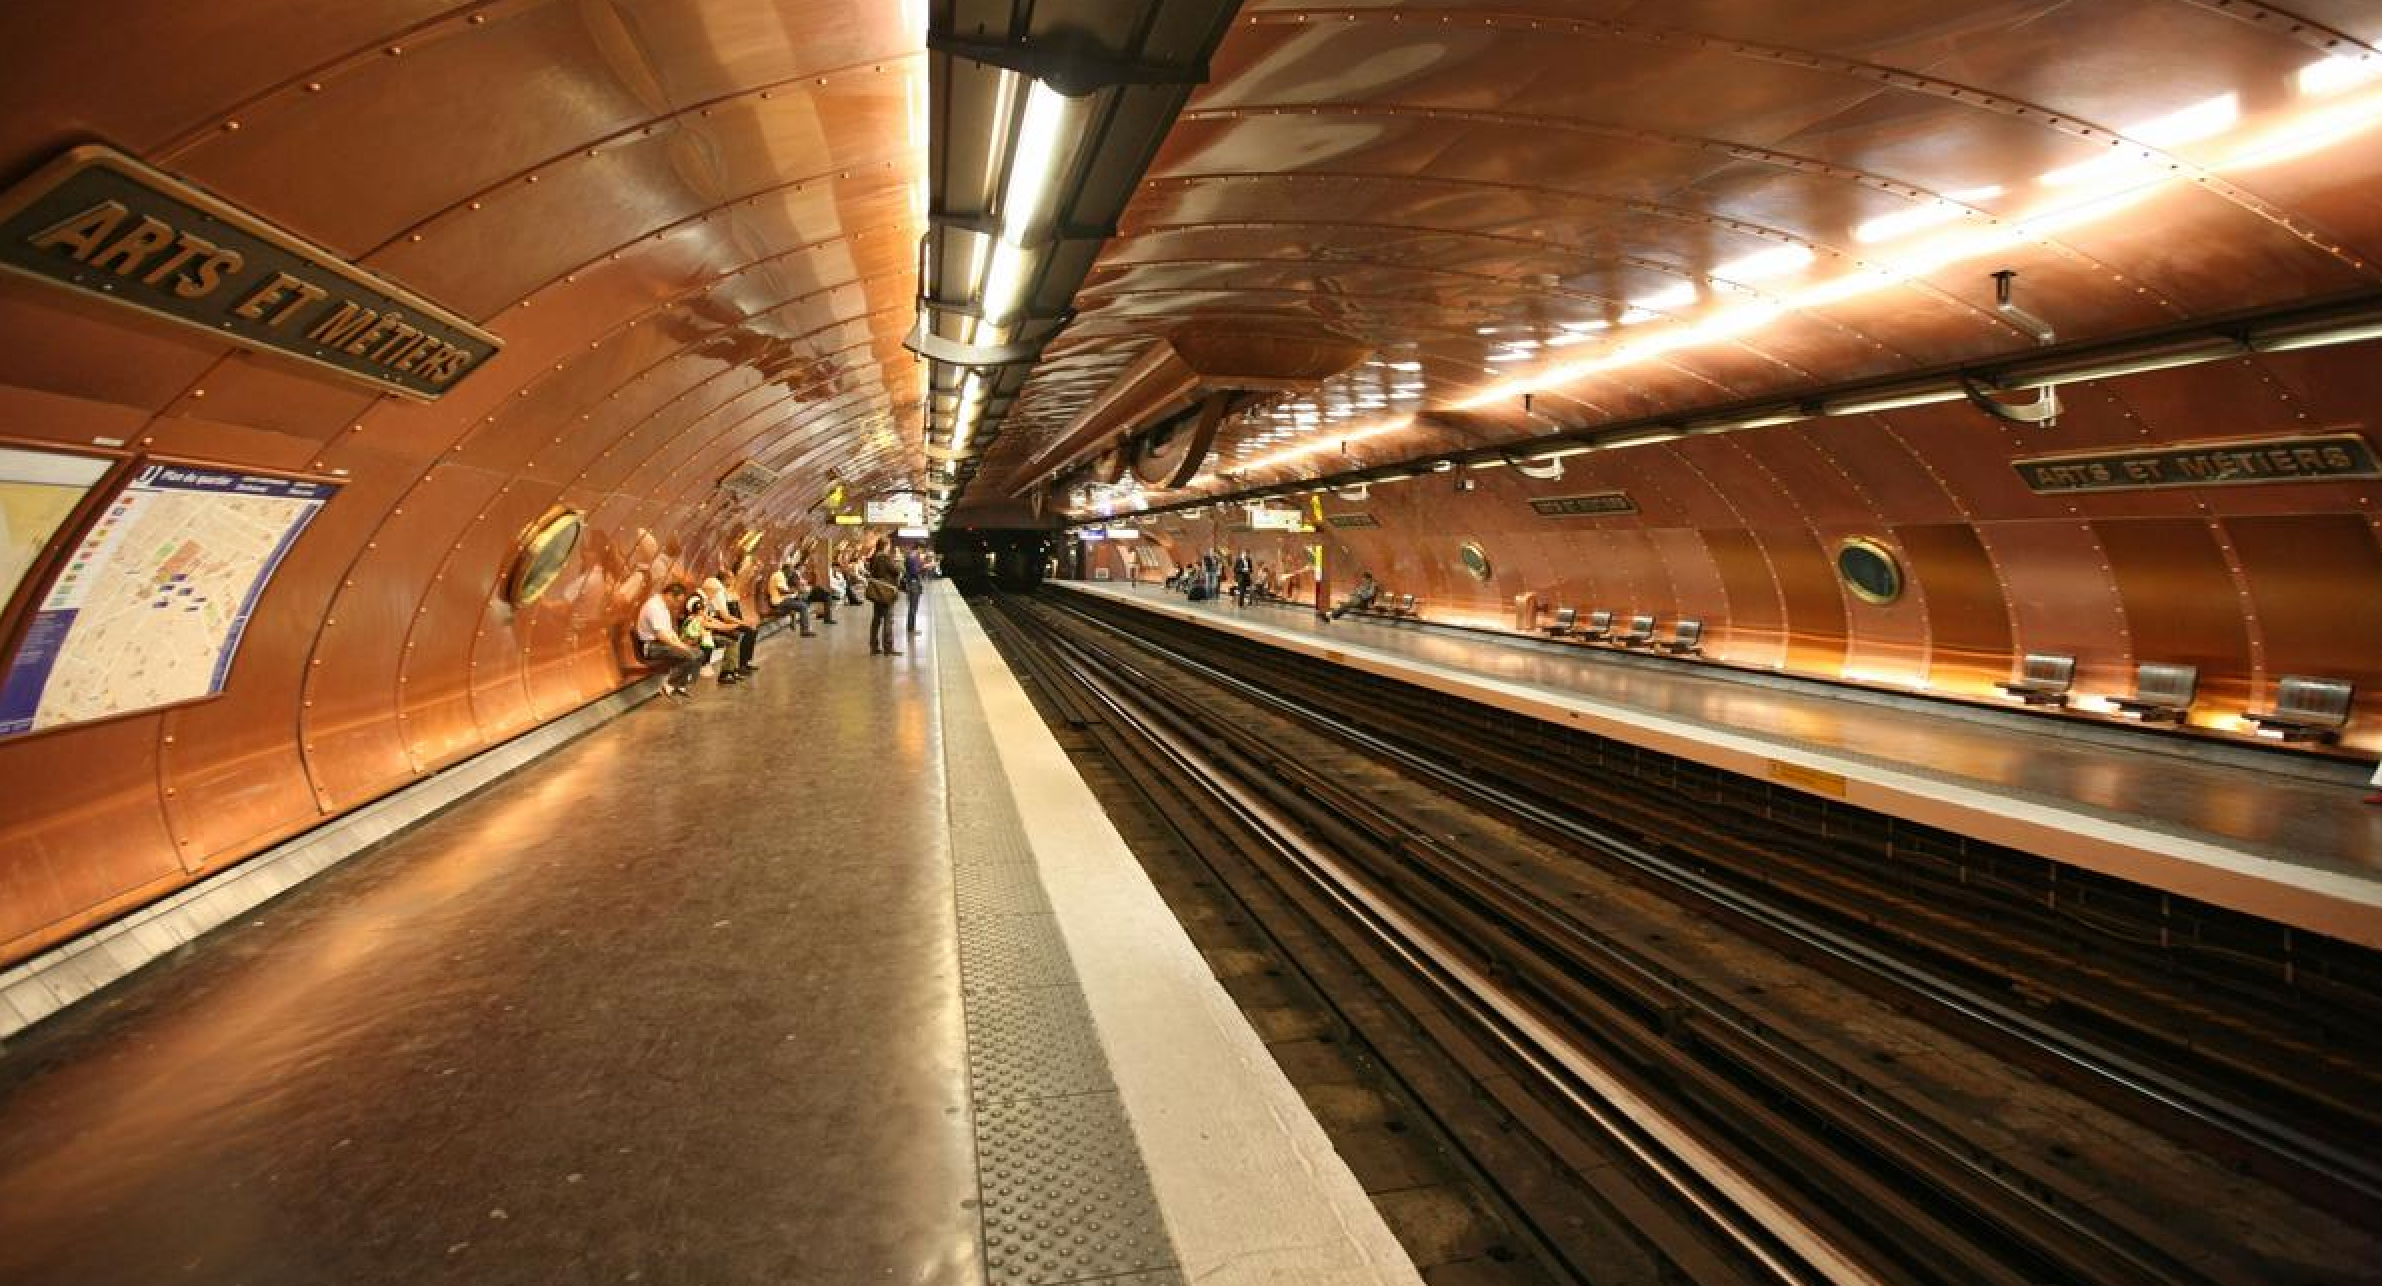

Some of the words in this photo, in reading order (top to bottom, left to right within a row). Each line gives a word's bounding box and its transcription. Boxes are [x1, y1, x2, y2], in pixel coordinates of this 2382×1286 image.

[27, 200, 245, 299] ARTS
[232, 271, 328, 328] ET
[306, 299, 472, 384] MÉTIERS
[2036, 463, 2110, 486] ARTS
[2122, 459, 2163, 480] ET
